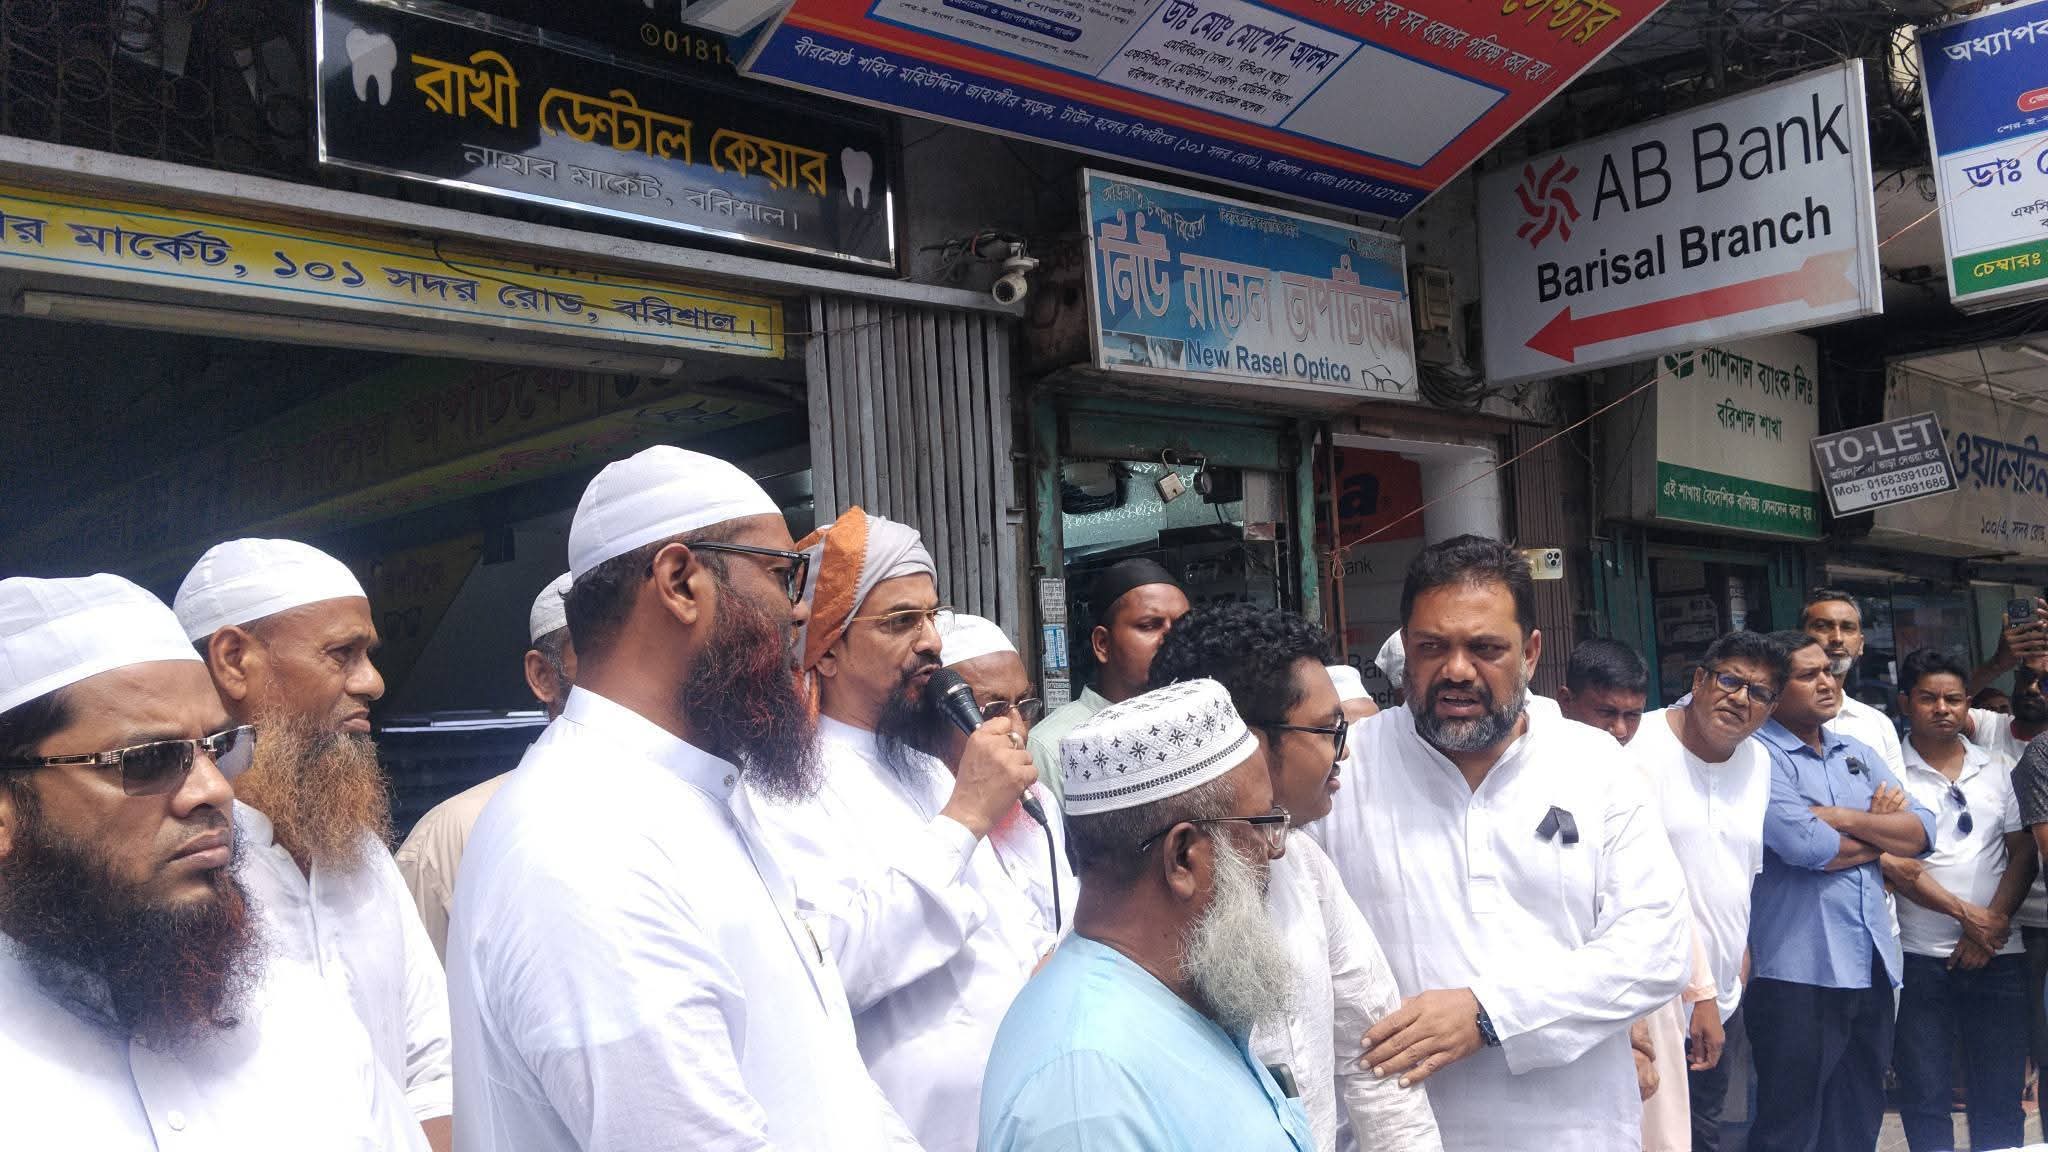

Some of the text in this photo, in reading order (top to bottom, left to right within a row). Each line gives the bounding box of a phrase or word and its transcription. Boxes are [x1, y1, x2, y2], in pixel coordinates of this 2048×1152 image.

[1191, 11, 1235, 42] মোঃ
[1289, 41, 1339, 75] আলম
[410, 49, 829, 197] রাখী ডেন্টাল কেয়ার
[1591, 92, 1852, 223] AB Bank
[1961, 156, 2023, 189] ডাঃ
[66, 222, 249, 279] মার্কেট,
[272, 250, 367, 288] ১০১
[380, 267, 481, 304] সদর
[1097, 208, 1171, 320] নিউ
[1179, 252, 1275, 340] রাসেল
[1536, 195, 1832, 303] Barisal Branch
[1184, 340, 1352, 385] New Rasel Optico
[1716, 397, 1783, 443] বরিশাল শাখা
[1816, 418, 1933, 468] TO-LET
[1834, 463, 1944, 498] Mob: 01683991020
[1870, 476, 1948, 503] 01715091686
